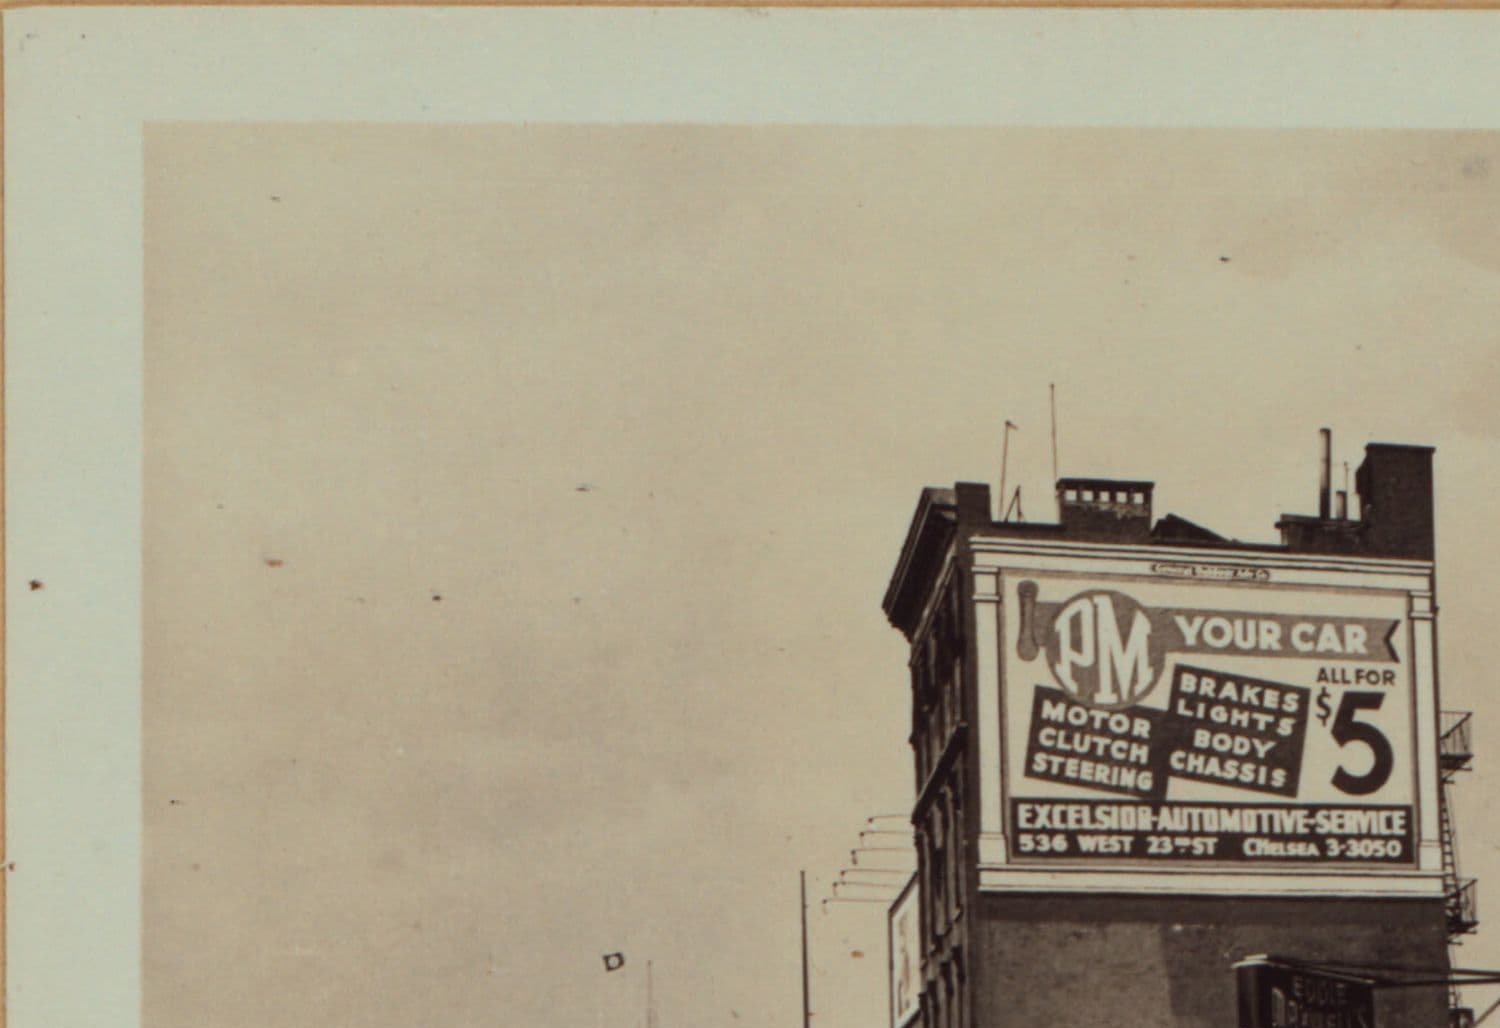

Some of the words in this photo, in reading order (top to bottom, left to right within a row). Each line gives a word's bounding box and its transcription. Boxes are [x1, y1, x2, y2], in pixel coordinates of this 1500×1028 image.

[1055, 594, 1154, 705] PM
[1174, 615, 1283, 650] YOUR
[1290, 623, 1368, 654] CAR
[1179, 672, 1300, 712] BRAKES
[1316, 667, 1353, 684] ALL
[1355, 669, 1396, 686] FOR
[1041, 699, 1152, 739] MOTOR
[1176, 698, 1297, 737] LIGHTS
[1038, 727, 1149, 764] CLUTCH
[1193, 729, 1276, 759] BODY
[1031, 752, 1154, 791] STEERING
[1169, 750, 1288, 788] CHASSIS
[1018, 833, 1068, 852] 536
[1077, 835, 1134, 853] WEST
[1325, 838, 1402, 858] 3-3050
